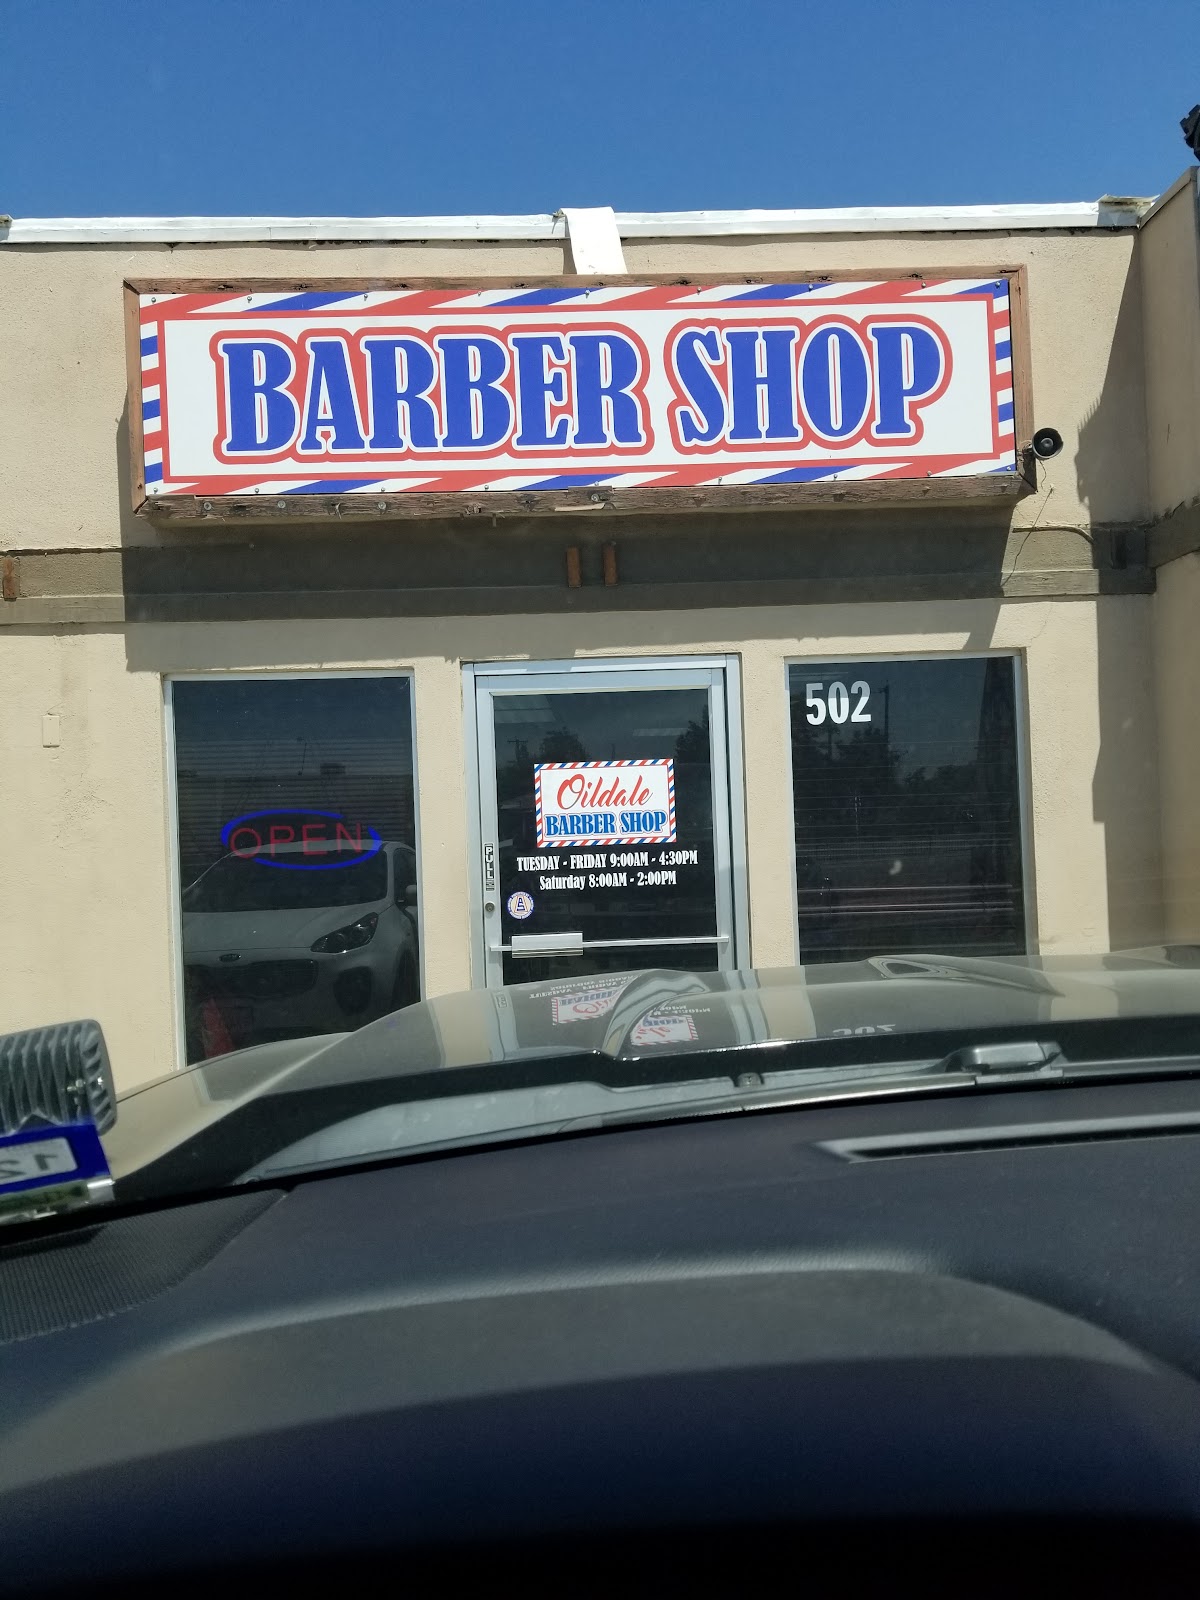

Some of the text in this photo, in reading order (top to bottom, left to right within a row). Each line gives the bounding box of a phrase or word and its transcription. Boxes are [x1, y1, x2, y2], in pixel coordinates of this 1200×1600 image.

[216, 321, 948, 459] BARBER SHOP
[806, 680, 872, 726] 502
[556, 773, 653, 810] Oildale
[230, 822, 363, 859] OPEN
[545, 810, 668, 836] BARBER SHOP
[485, 846, 494, 879] PULL
[516, 855, 560, 872] TUESDAY
[570, 853, 608, 869] FRIDAY
[610, 851, 649, 868] 9:00AM
[658, 850, 699, 866] 4:30PM
[539, 874, 586, 890] Saturday
[588, 872, 628, 888] 8:00AM
[637, 870, 677, 886] 2:00PM
